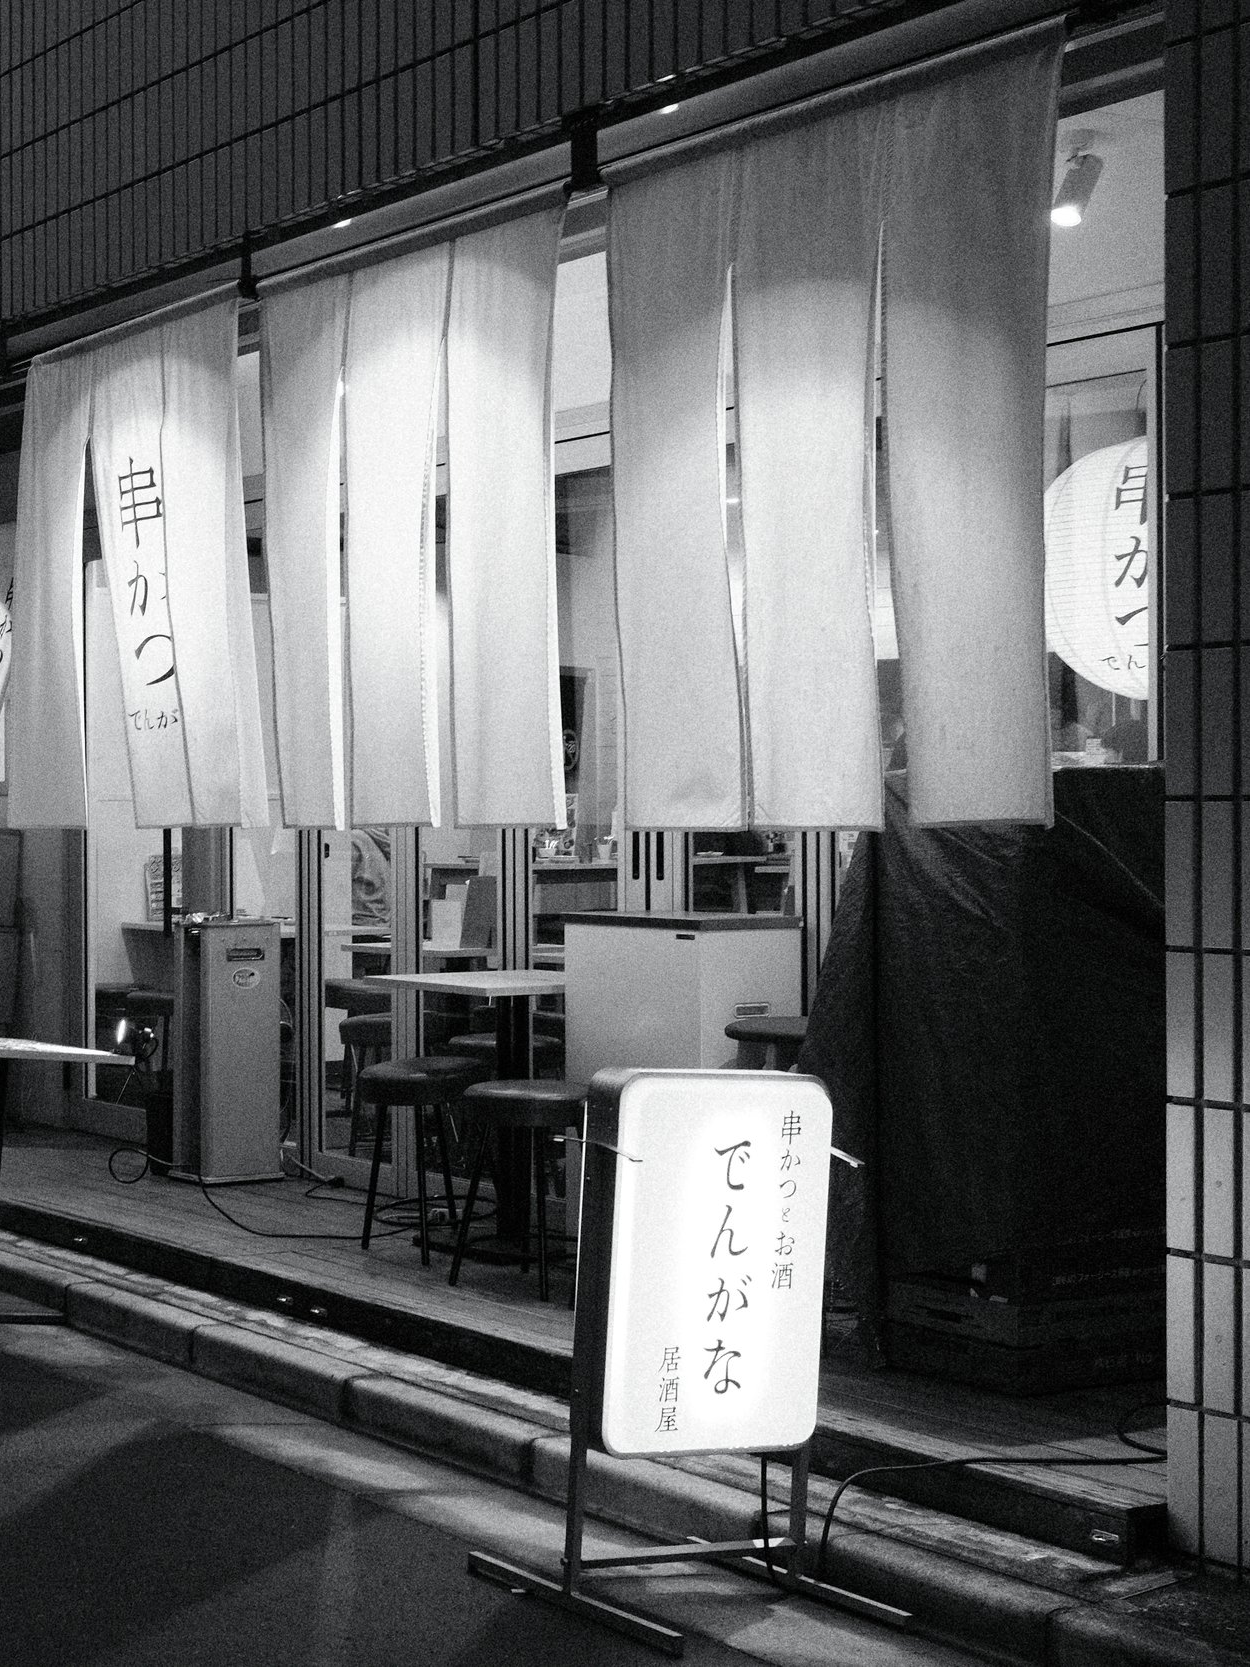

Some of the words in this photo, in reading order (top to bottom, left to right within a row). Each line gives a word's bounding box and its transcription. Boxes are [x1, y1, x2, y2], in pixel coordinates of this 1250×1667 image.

[703, 1140, 752, 1395] でんがな
[771, 1110, 802, 1291] 串かつとお酒
[654, 1346, 681, 1433] 居酒屋
